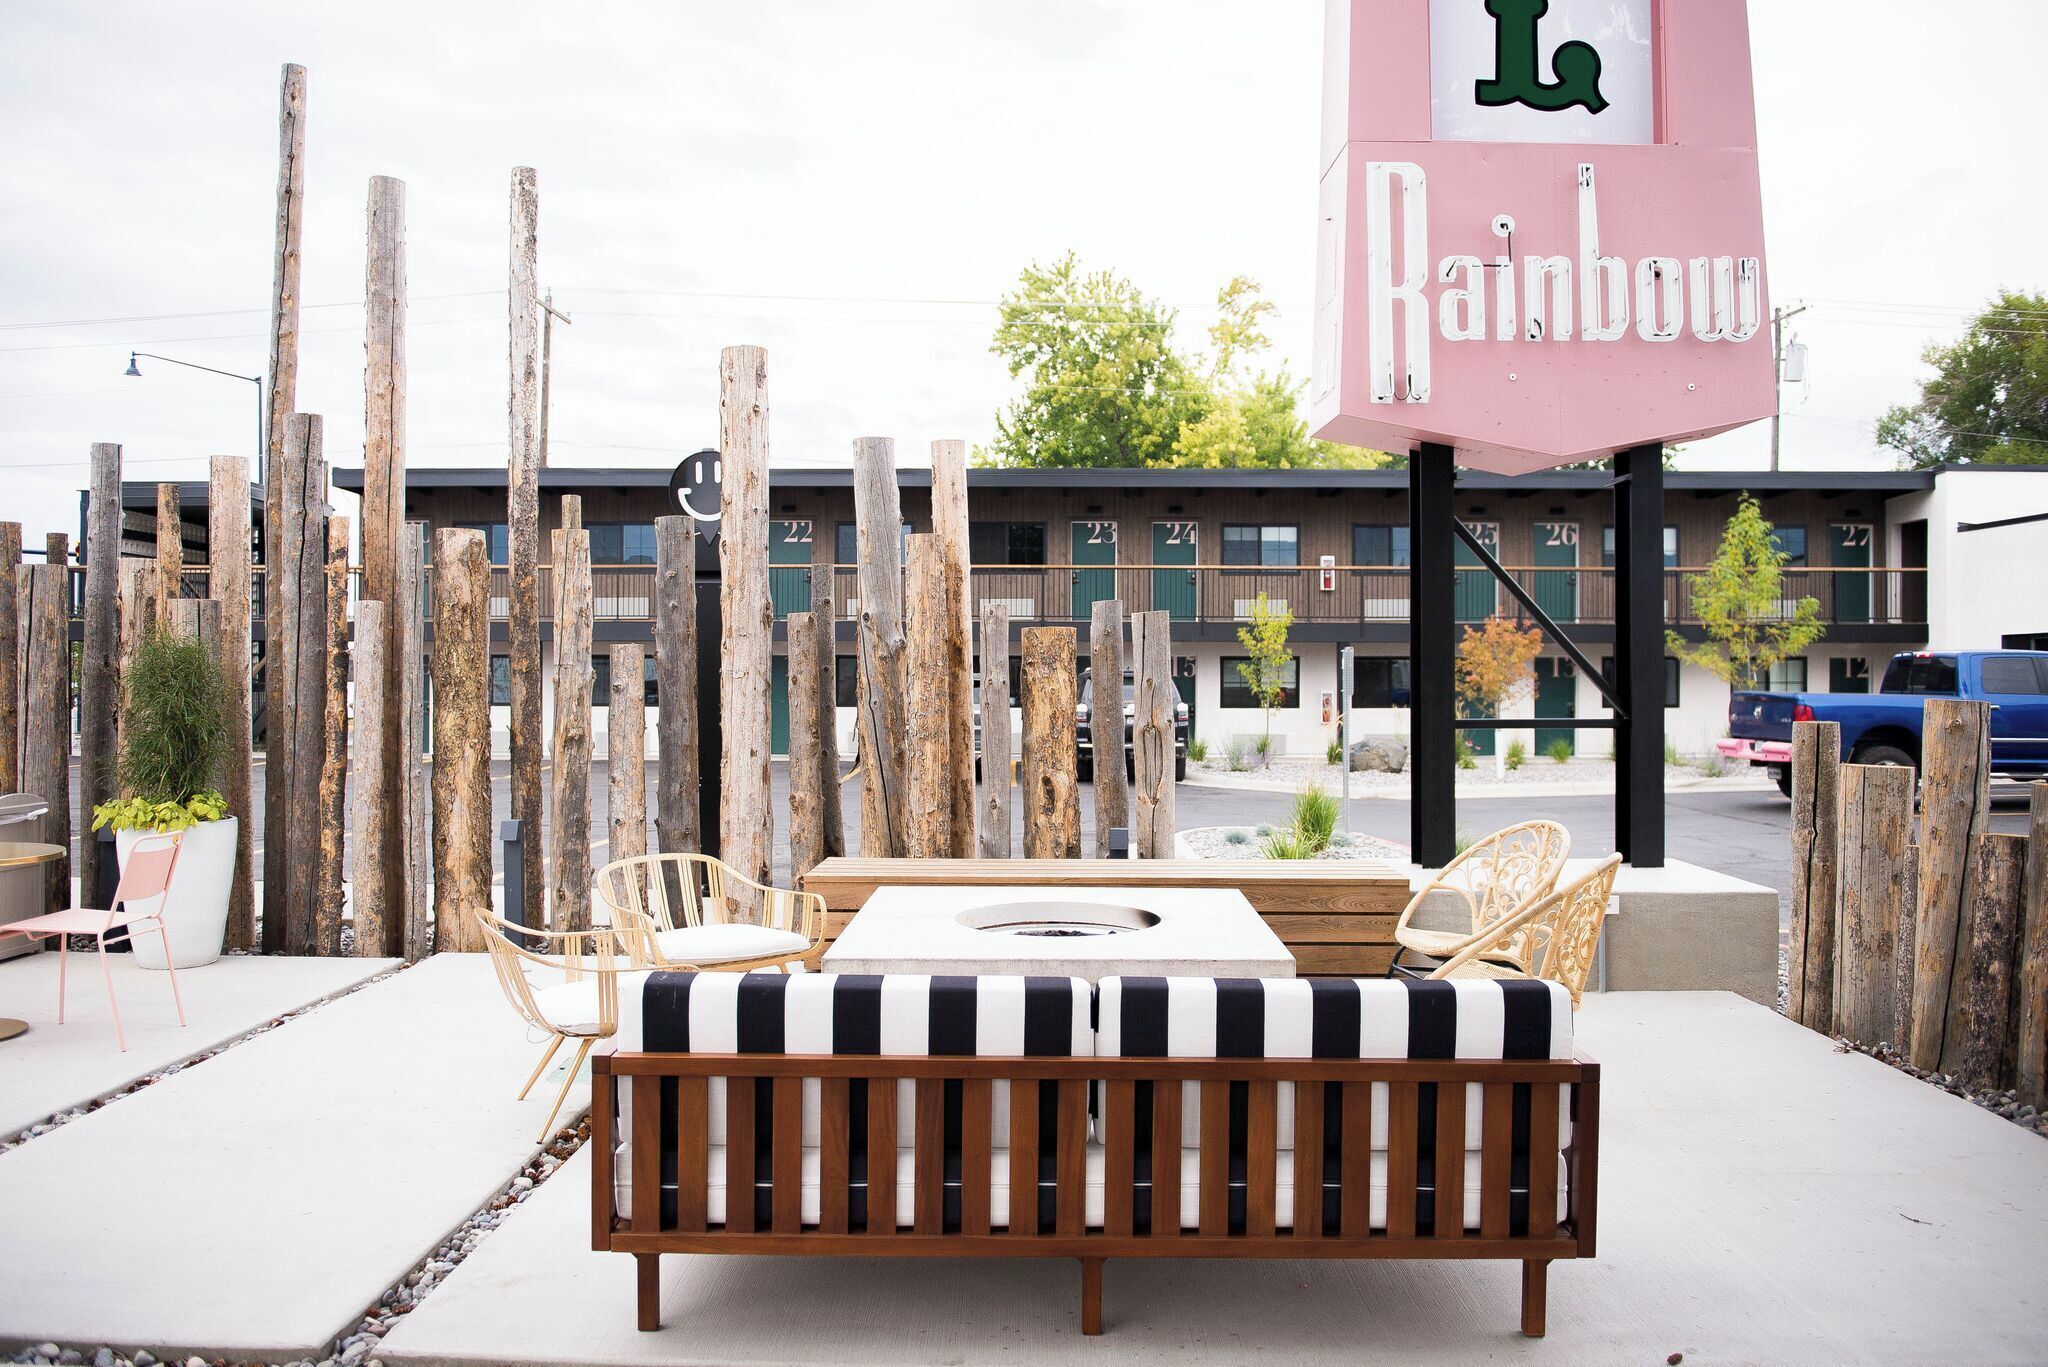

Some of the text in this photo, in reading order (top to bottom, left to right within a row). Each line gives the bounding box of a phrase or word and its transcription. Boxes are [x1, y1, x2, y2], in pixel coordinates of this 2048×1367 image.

[1475, 0, 1610, 115] L
[1366, 161, 1761, 404] Rainbow
[783, 520, 813, 543] 22
[1086, 521, 1117, 544] 23
[1165, 522, 1197, 545] 24
[1468, 522, 1498, 546] 25
[1545, 522, 1578, 546] 26
[1842, 524, 1873, 547] 27
[1171, 655, 1198, 678] 15
[1845, 655, 1870, 678] 12
